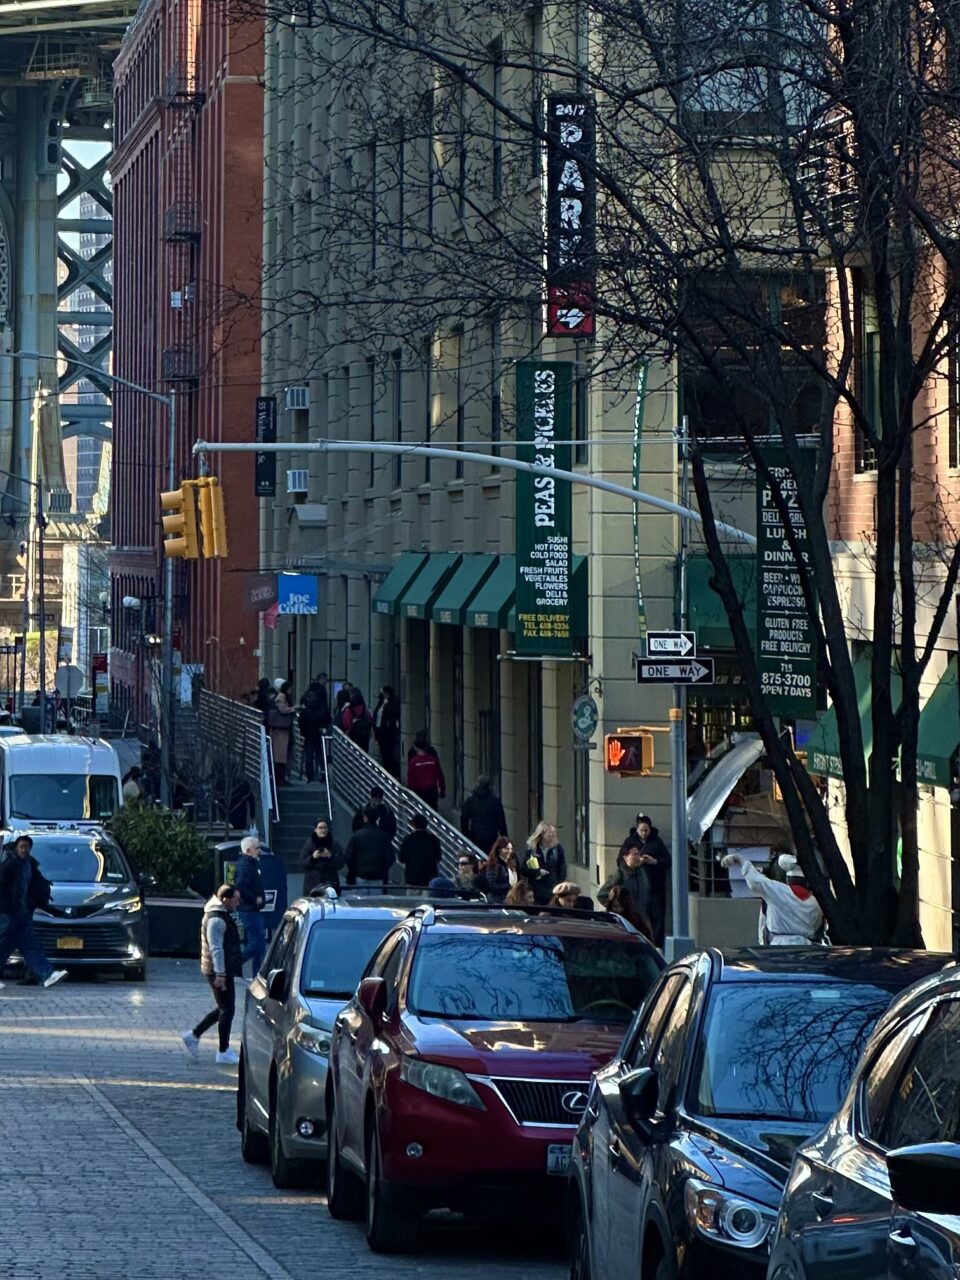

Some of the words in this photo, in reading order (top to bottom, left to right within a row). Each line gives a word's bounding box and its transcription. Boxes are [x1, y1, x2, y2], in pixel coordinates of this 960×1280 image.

[555, 104, 586, 116] 24/7
[534, 477, 555, 527] PEAS
[764, 550, 809, 563] DINNR
[535, 582, 568, 590] FLOWERS
[286, 592, 310, 606] Joe
[546, 590, 561, 598] DELI
[277, 603, 318, 615] Coffee
[537, 614, 570, 622] DELIVERY
[764, 617, 790, 629] GLUTEN
[791, 619, 809, 630] FREE
[769, 629, 804, 641] PRODUCTS
[654, 640, 668, 650] ONE
[674, 640, 688, 650] WAY
[760, 640, 779, 652] FREE
[780, 641, 812, 654] DELIVERY
[647, 666, 670, 677] ONE
[679, 666, 701, 677] WAY
[761, 672, 812, 687] 875-3700
[783, 686, 789, 696] 7
[790, 687, 812, 698] DAYS
